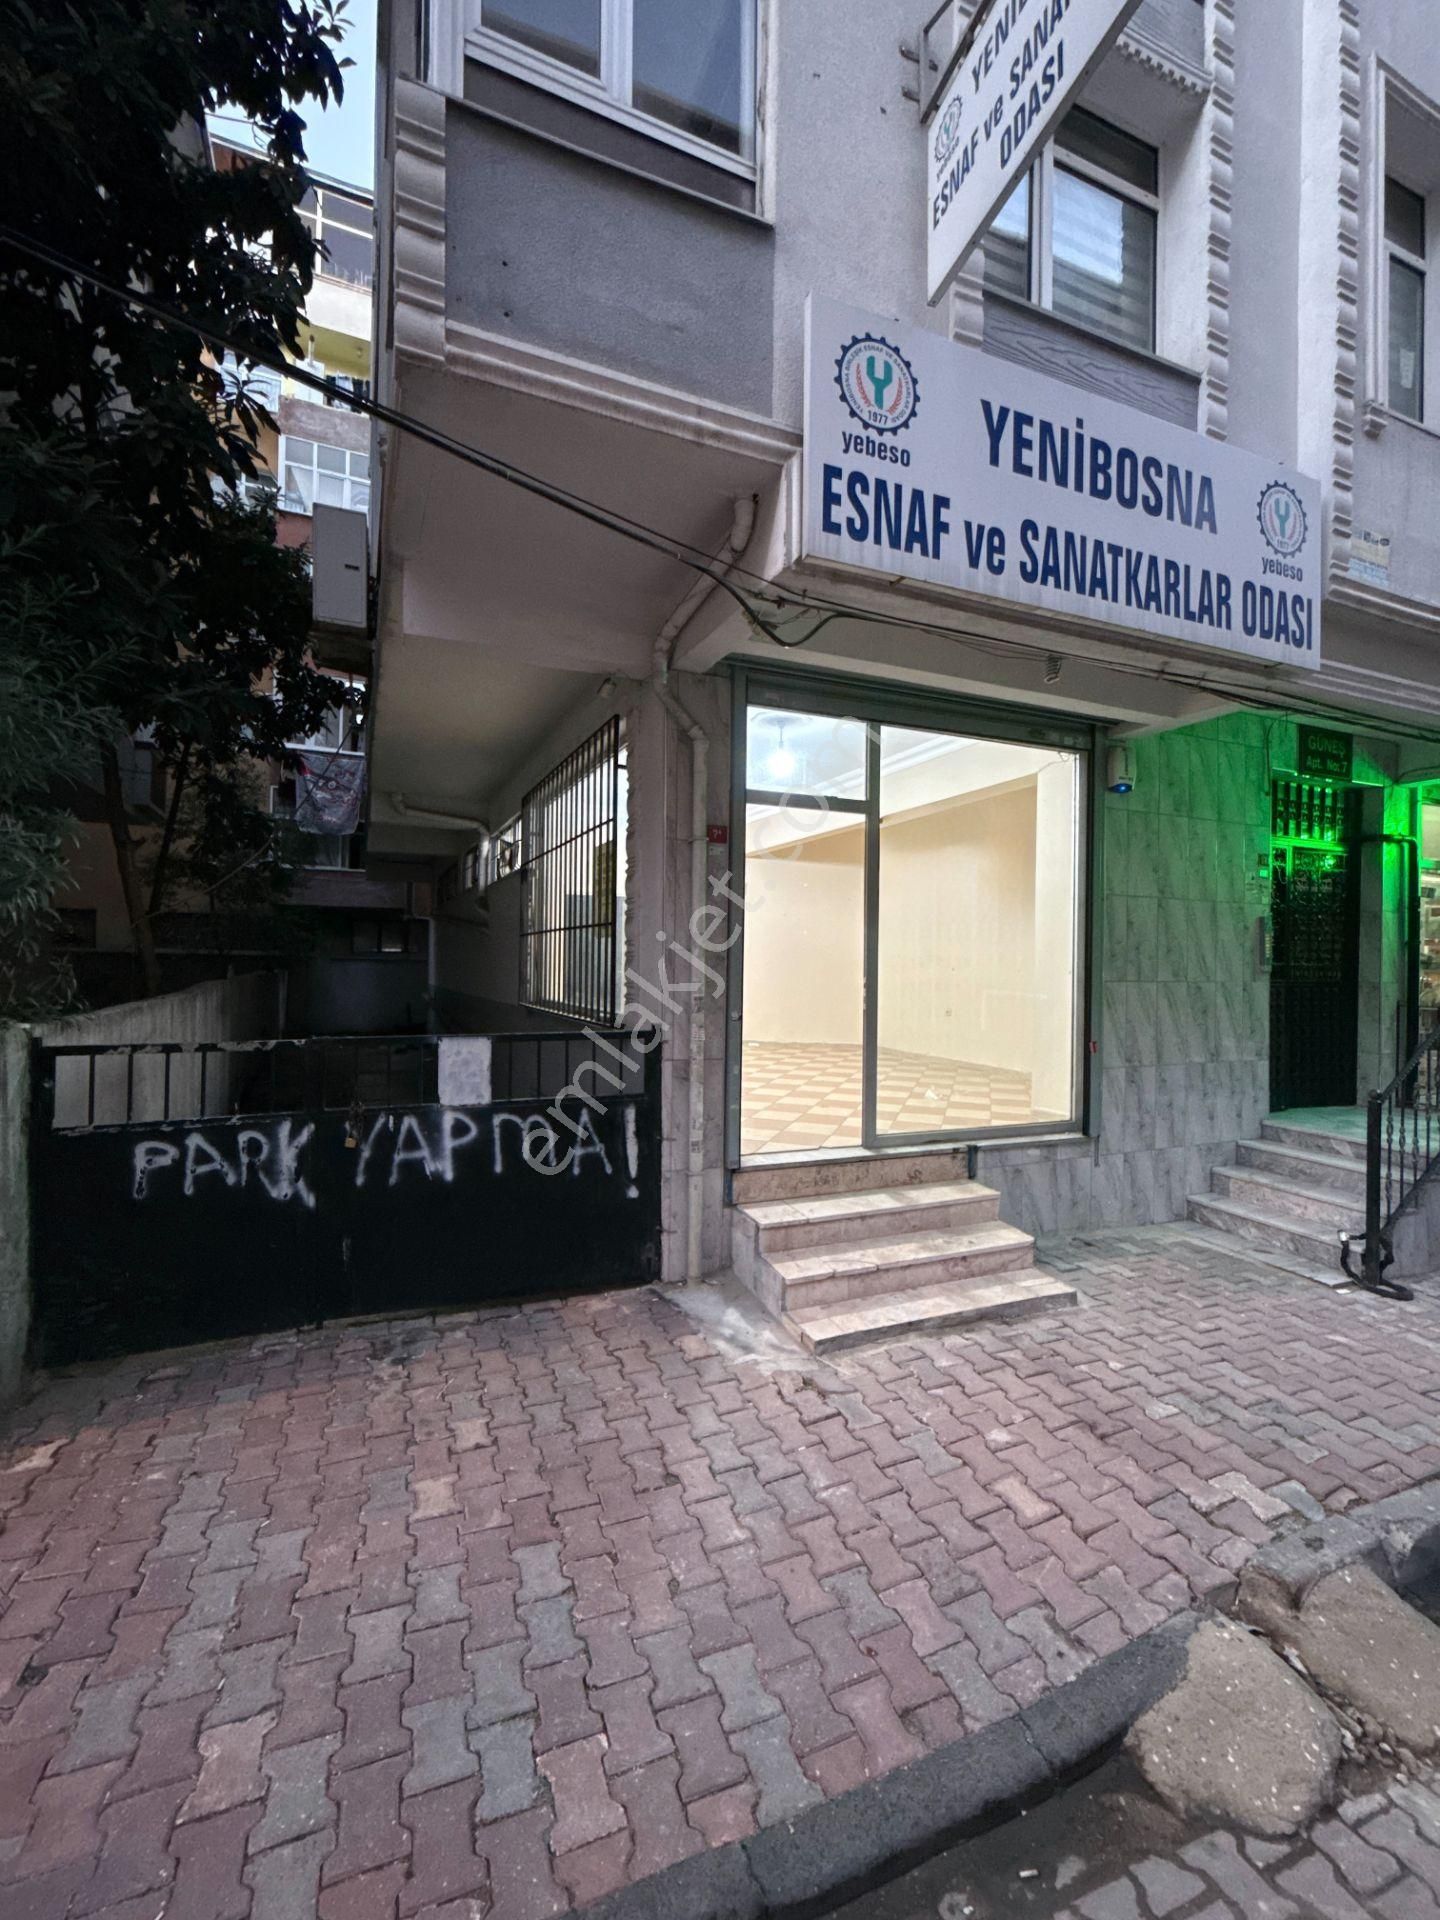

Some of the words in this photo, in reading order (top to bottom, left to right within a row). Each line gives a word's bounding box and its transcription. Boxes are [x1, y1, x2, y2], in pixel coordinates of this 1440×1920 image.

[1000, 37, 1064, 169] ODASI
[933, 127, 979, 230] ESNAF
[983, 94, 1003, 141] ve
[842, 430, 911, 467] yebeso
[867, 410, 888, 426] 1977
[980, 398, 1218, 534] YENİBOSNA
[822, 463, 950, 560] ESNAF
[964, 519, 1006, 575] ve
[1019, 518, 1232, 631] SANATKARLAR
[1242, 580, 1313, 650] ODASI
[1262, 556, 1303, 582] yebeso
[132, 1119, 316, 1209] PARK
